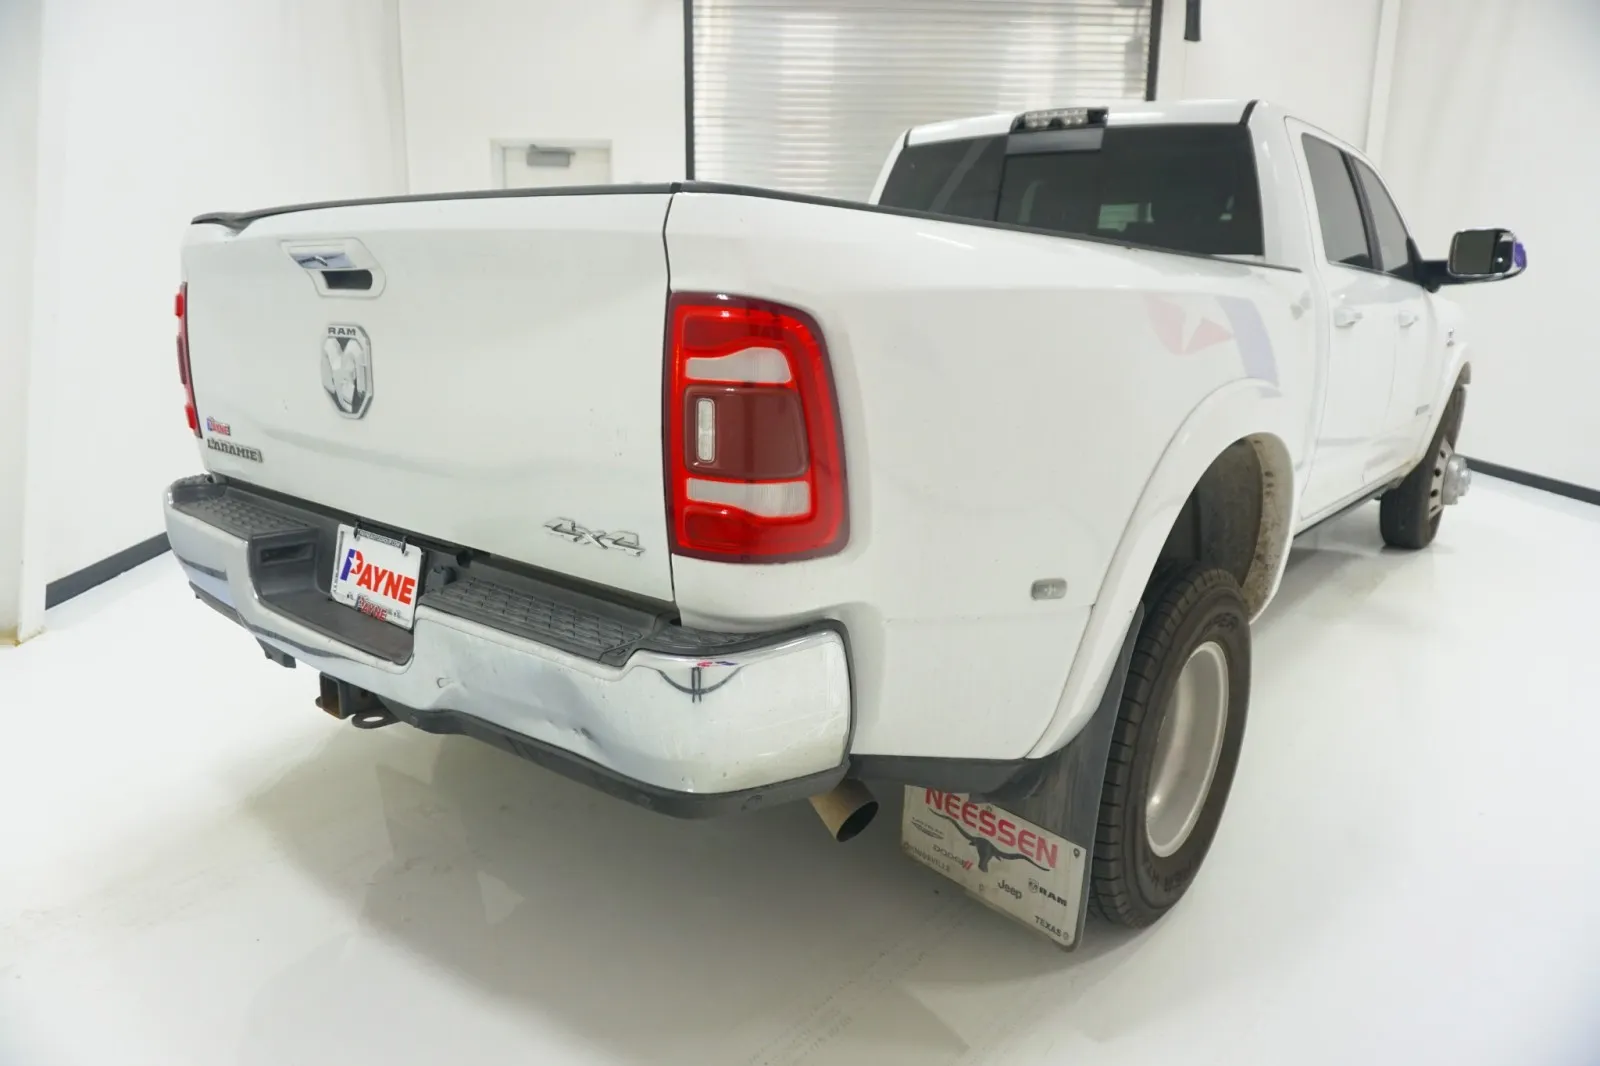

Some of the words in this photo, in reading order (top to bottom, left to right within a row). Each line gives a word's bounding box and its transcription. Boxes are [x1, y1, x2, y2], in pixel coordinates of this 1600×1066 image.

[328, 327, 356, 336] RAM
[206, 438, 262, 462] LARAMIE
[340, 548, 416, 605] PAYNE
[355, 594, 388, 622] PAYNE
[925, 787, 1059, 869] NEESSEN
[997, 879, 1022, 899] Jeep
[1039, 887, 1068, 907] RAM
[1034, 914, 1062, 938] TEXAS
